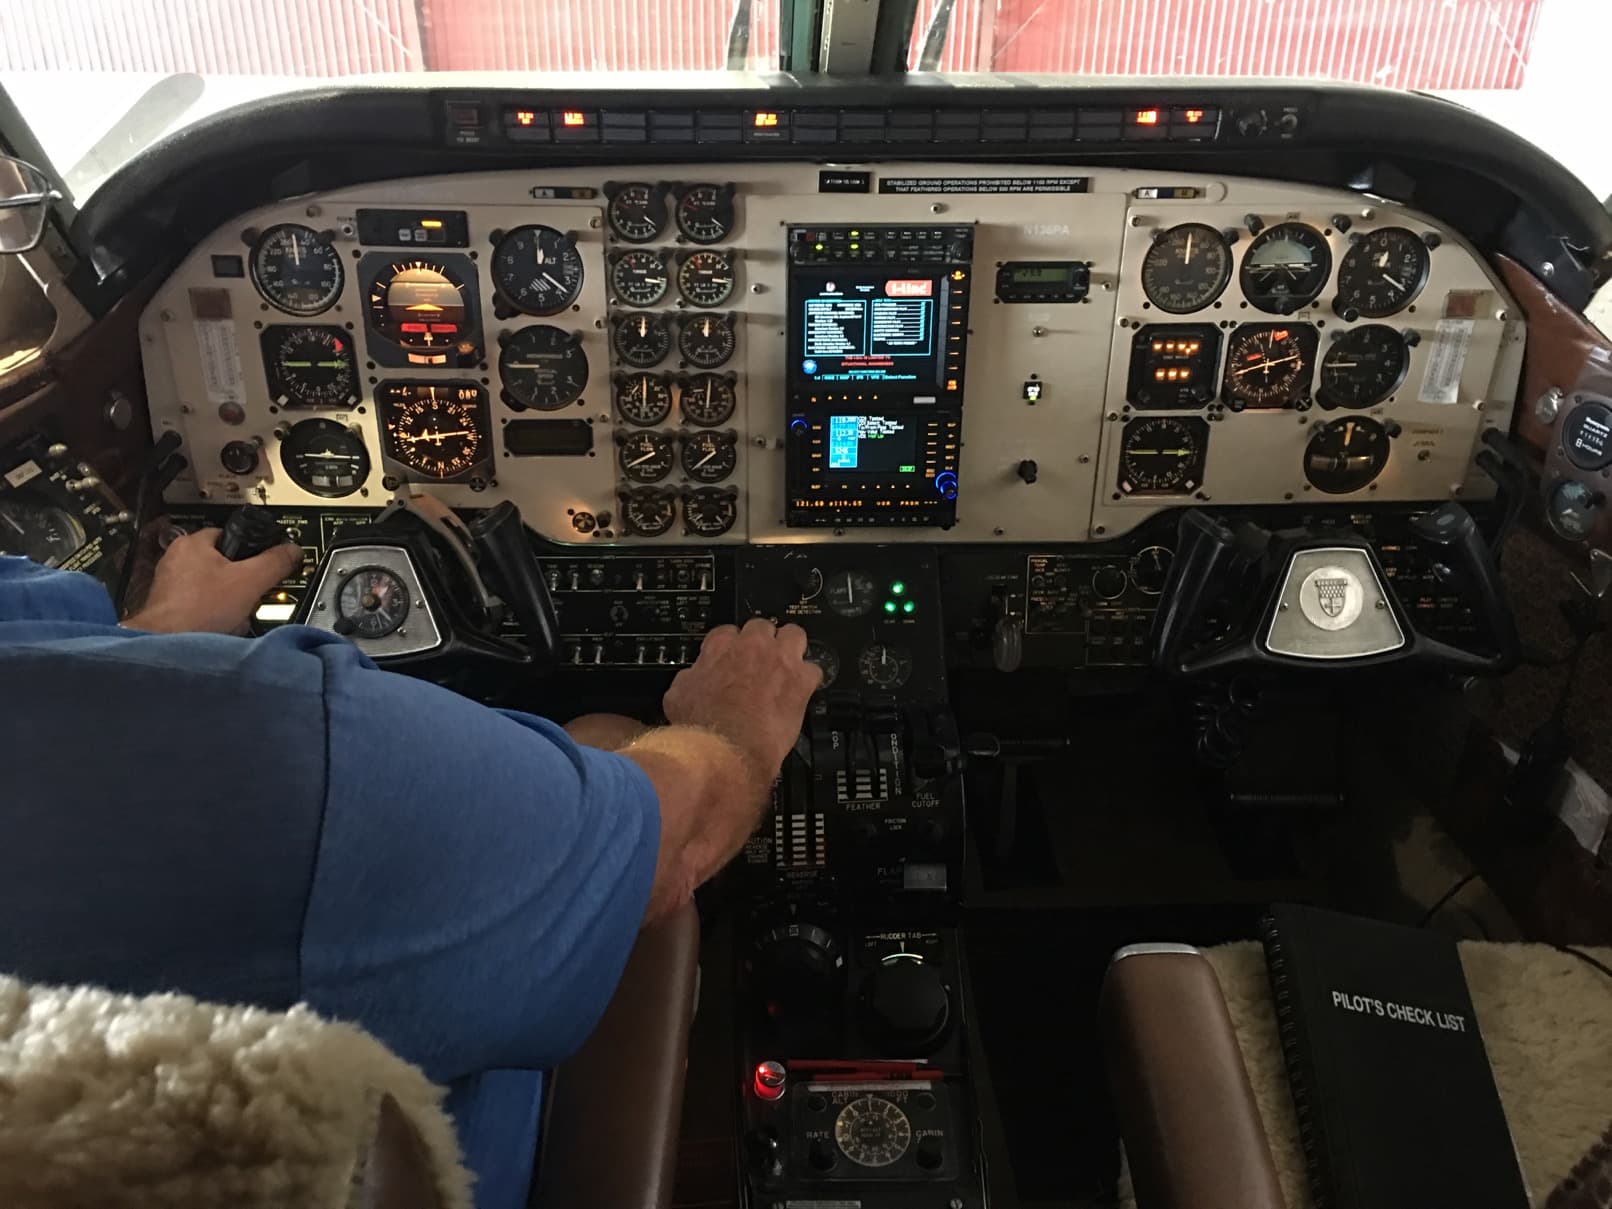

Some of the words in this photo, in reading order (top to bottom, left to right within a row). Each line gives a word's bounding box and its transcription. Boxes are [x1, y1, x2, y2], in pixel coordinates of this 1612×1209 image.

[890, 732, 903, 797] ONDITION
[846, 802, 881, 811] FEATHER
[912, 800, 940, 808] CUTOFF
[880, 932, 906, 941] RUDDER
[1332, 991, 1384, 1016] PILOT'S
[1386, 1002, 1436, 1027] CHECK
[1436, 1012, 1465, 1032] LIST
[915, 1129, 944, 1138] CABIN
